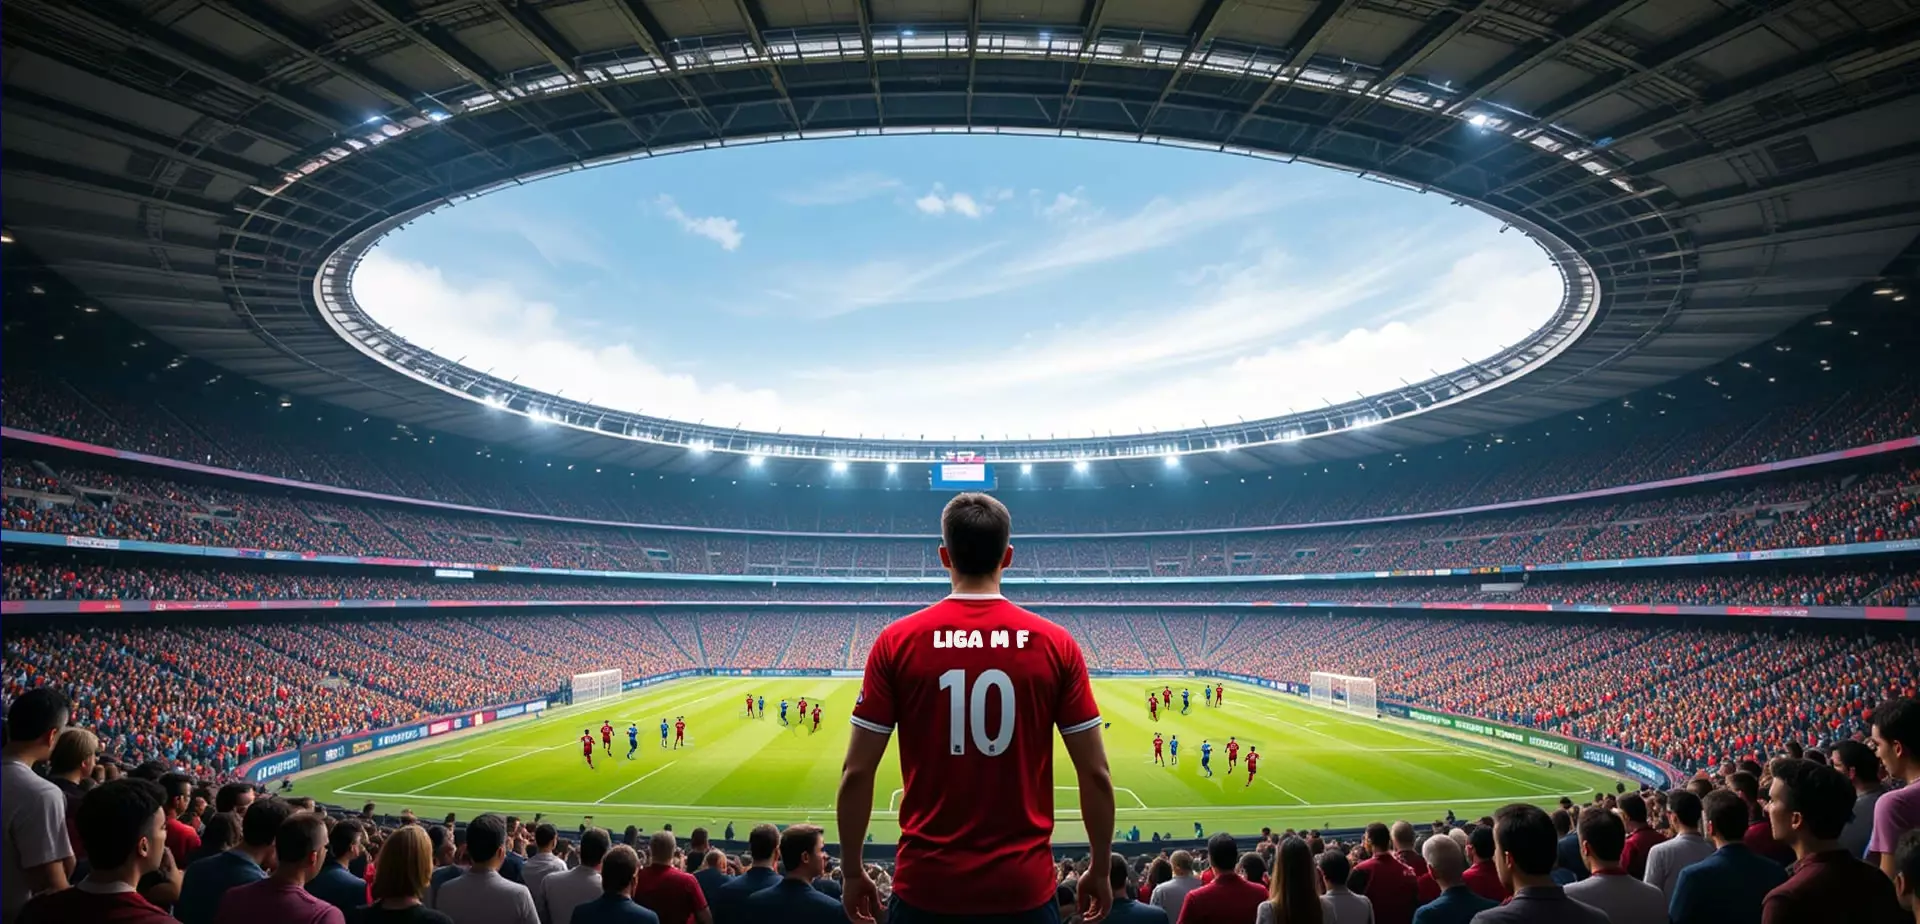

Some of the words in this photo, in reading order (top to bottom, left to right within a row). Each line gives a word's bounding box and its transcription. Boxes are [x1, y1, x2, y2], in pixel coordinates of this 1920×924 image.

[933, 630, 984, 649] LIGA
[990, 630, 1010, 649] M
[1016, 630, 1030, 649] F
[939, 668, 1016, 757] 10
